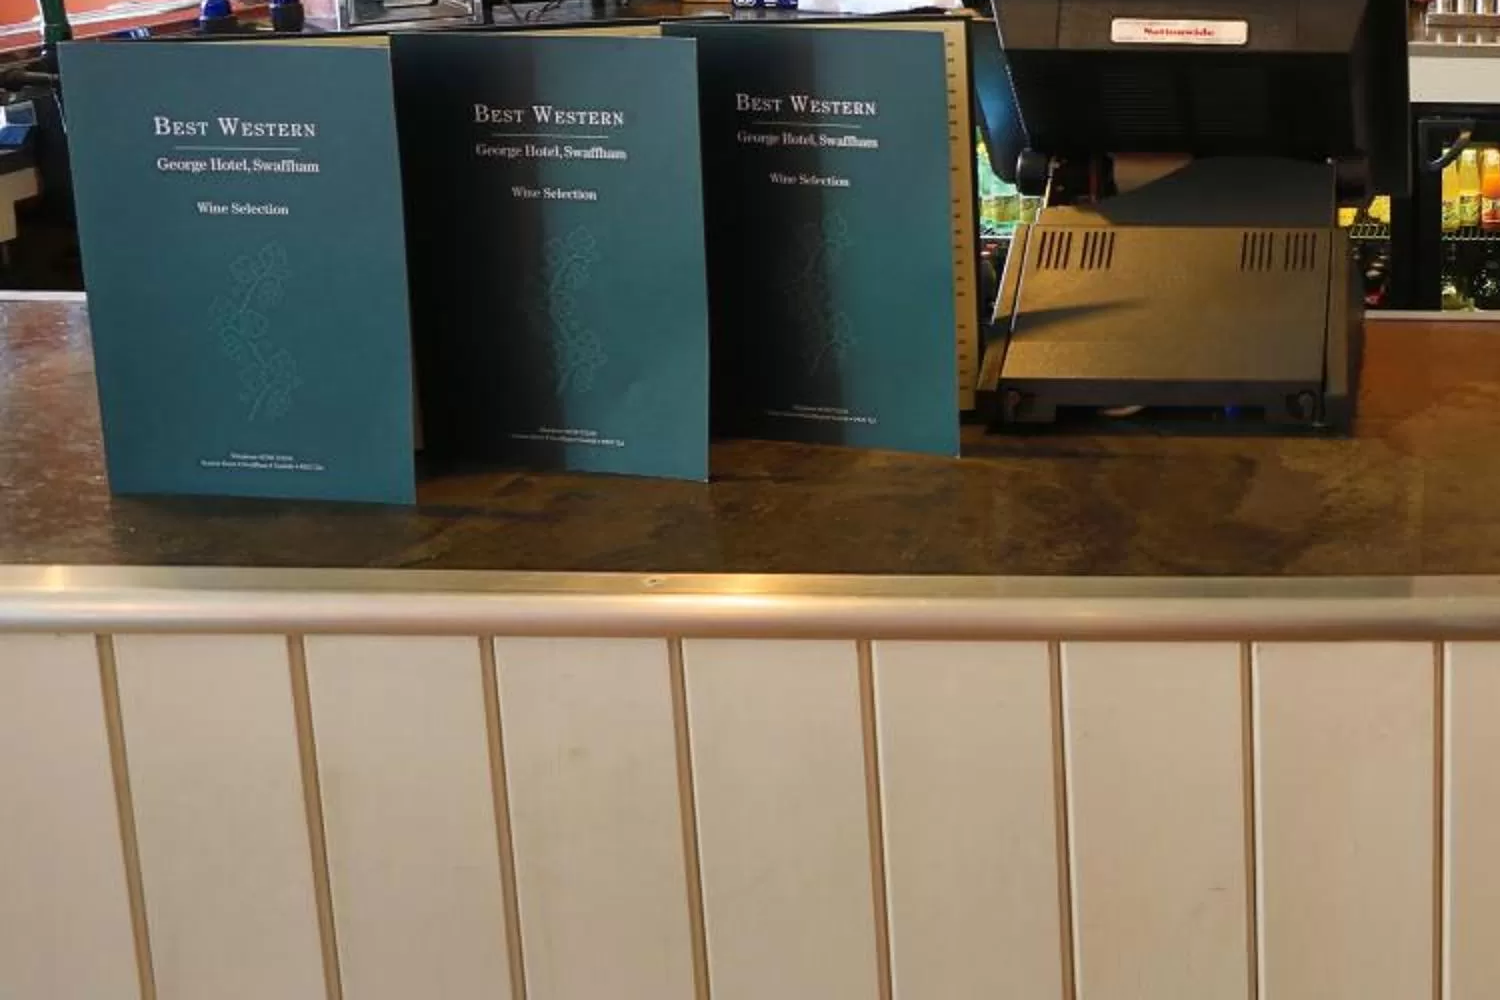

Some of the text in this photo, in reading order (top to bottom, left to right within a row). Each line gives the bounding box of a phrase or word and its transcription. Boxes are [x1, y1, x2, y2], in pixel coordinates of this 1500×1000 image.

[473, 104, 624, 126] BEST WESTERN
[153, 116, 316, 137] BEST WESTERN
[475, 144, 522, 159] George
[563, 146, 627, 161] Swaffham
[157, 157, 320, 173] George Hotel, Swaffham
[769, 172, 850, 187] Wine Selection
[511, 185, 597, 201] Wine Selection
[197, 201, 290, 216] Wine Selection
